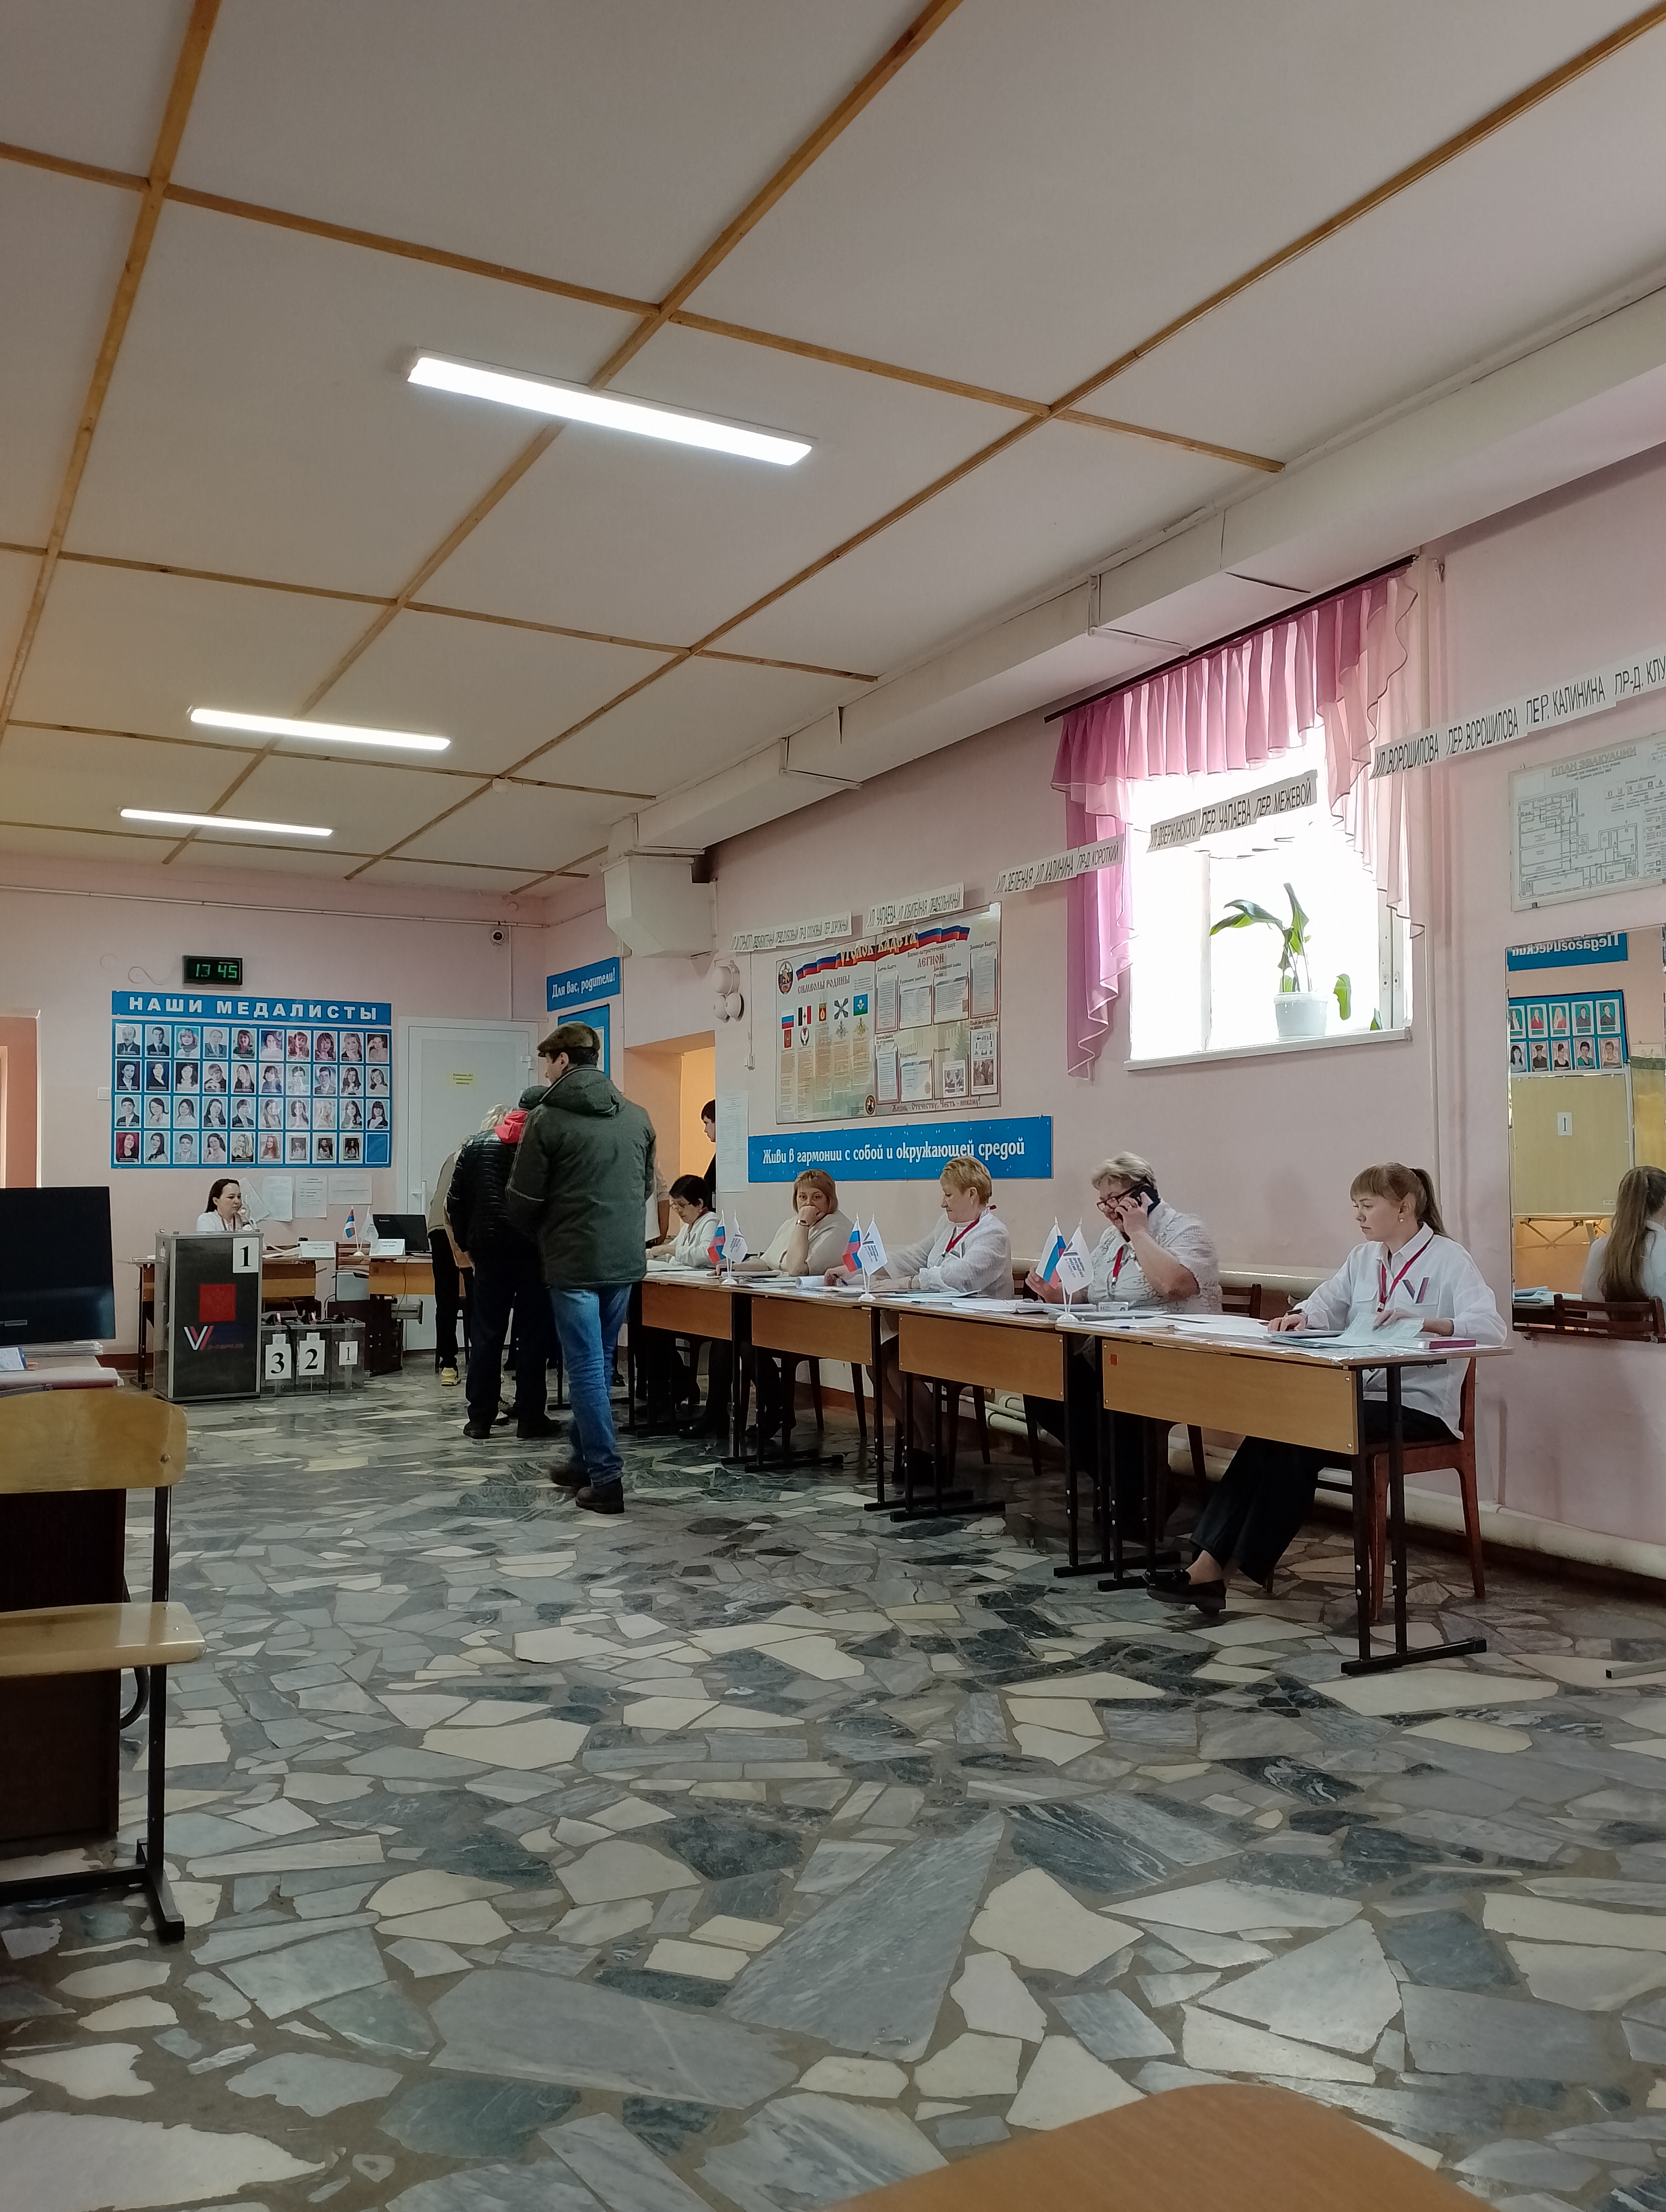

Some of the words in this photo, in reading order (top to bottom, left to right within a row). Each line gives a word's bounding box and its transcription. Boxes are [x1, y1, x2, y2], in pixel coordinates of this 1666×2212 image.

[1614, 666, 1643, 696] ПР-Д.
[1526, 695, 1549, 725] ПЕР.
[1552, 676, 1606, 717] КАЛИНИНА
[1446, 726, 1463, 755] ПЕР.
[1465, 706, 1518, 751] ВОРОШИЛОВА
[1386, 732, 1439, 774] ВОРОШИЛОВА
[1552, 762, 1577, 776] ПЛАН
[1253, 795, 1271, 818] ПЕР.
[1273, 777, 1311, 813] МЕЖЕВОЙ
[1199, 809, 1215, 835] ПЕР.
[1219, 798, 1251, 829] ЧАПАЕВА
[1156, 816, 1196, 851] ДЗЕРЖИНСКОГО
[1091, 841, 1119, 866] КОРОТКИЙ
[1008, 867, 1033, 891] ЗЕЛЕНАЯ
[1043, 854, 1073, 882] КАЛИНИНА
[218, 965, 238, 978] 45
[917, 953, 944, 968] ЛЕГИОН
[552, 984, 565, 999] Для
[581, 967, 616, 994] родители!
[797, 981, 825, 995] СИМВОЛЫ
[826, 975, 851, 988] РОДИНЫ
[129, 996, 202, 1013] НАШИ
[217, 1001, 377, 1020] МЕДАЛИСТЫ
[762, 1149, 786, 1164] Живи
[797, 1149, 842, 1166] гармонии
[845, 1149, 850, 1161] с
[853, 1143, 883, 1160] собой
[886, 1147, 893, 1159] и
[896, 1139, 974, 1163] окружающей
[978, 1137, 1025, 1160] средой
[240, 1245, 252, 1267] 1
[271, 1353, 285, 1373] 3
[305, 1348, 318, 1369] 2
[345, 1346, 351, 1360] 1
